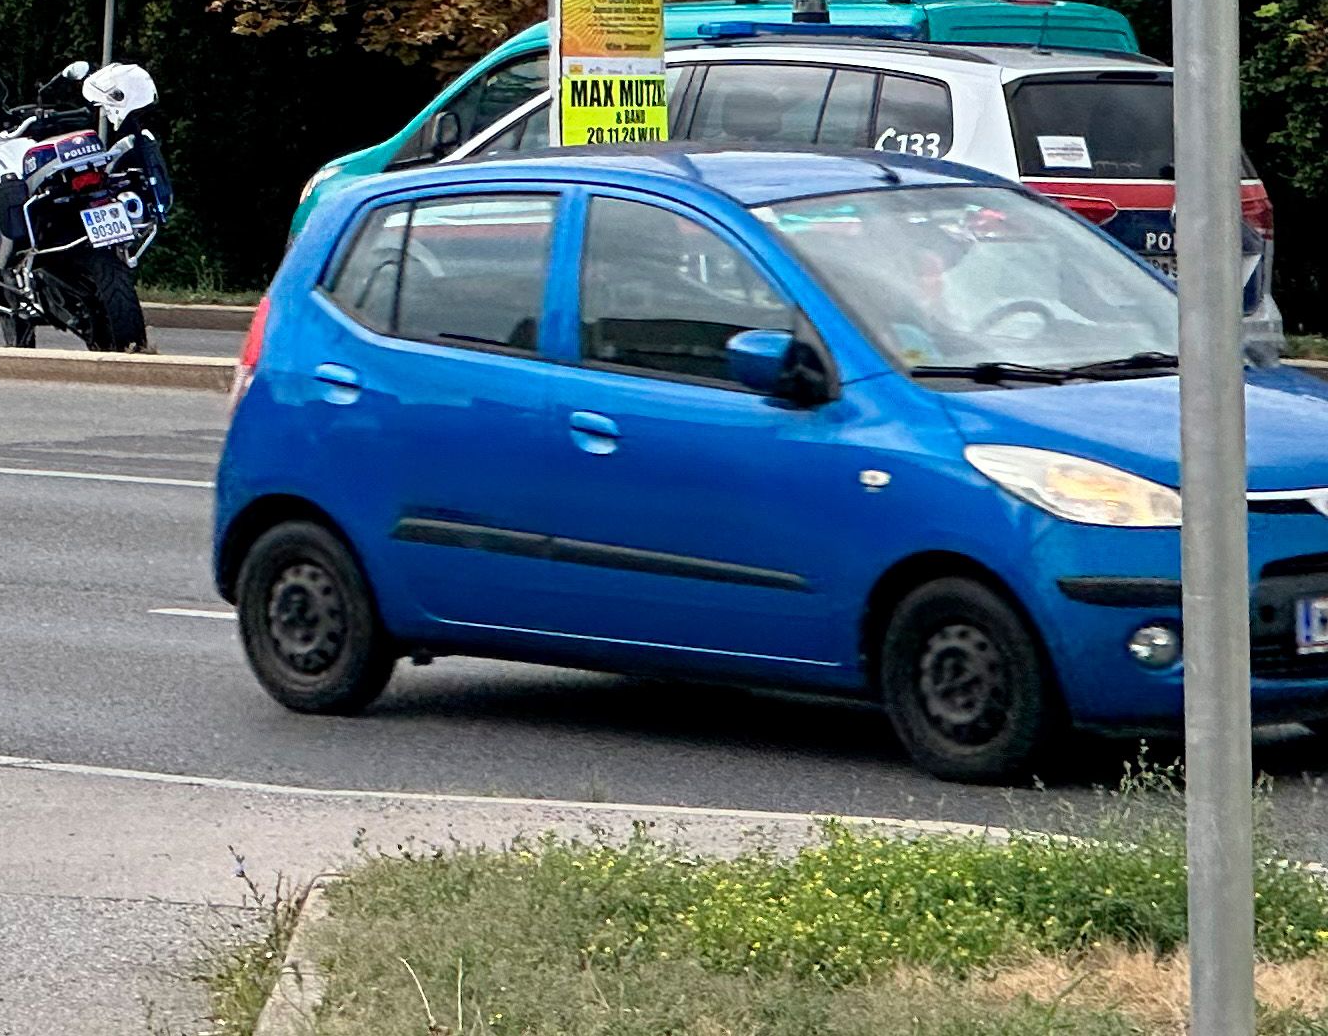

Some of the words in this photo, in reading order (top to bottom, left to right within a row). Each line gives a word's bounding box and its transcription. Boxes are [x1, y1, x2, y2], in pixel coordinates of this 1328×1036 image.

[571, 79, 615, 107] MAX
[64, 144, 101, 160] POLIZEI
[896, 132, 941, 159] 133
